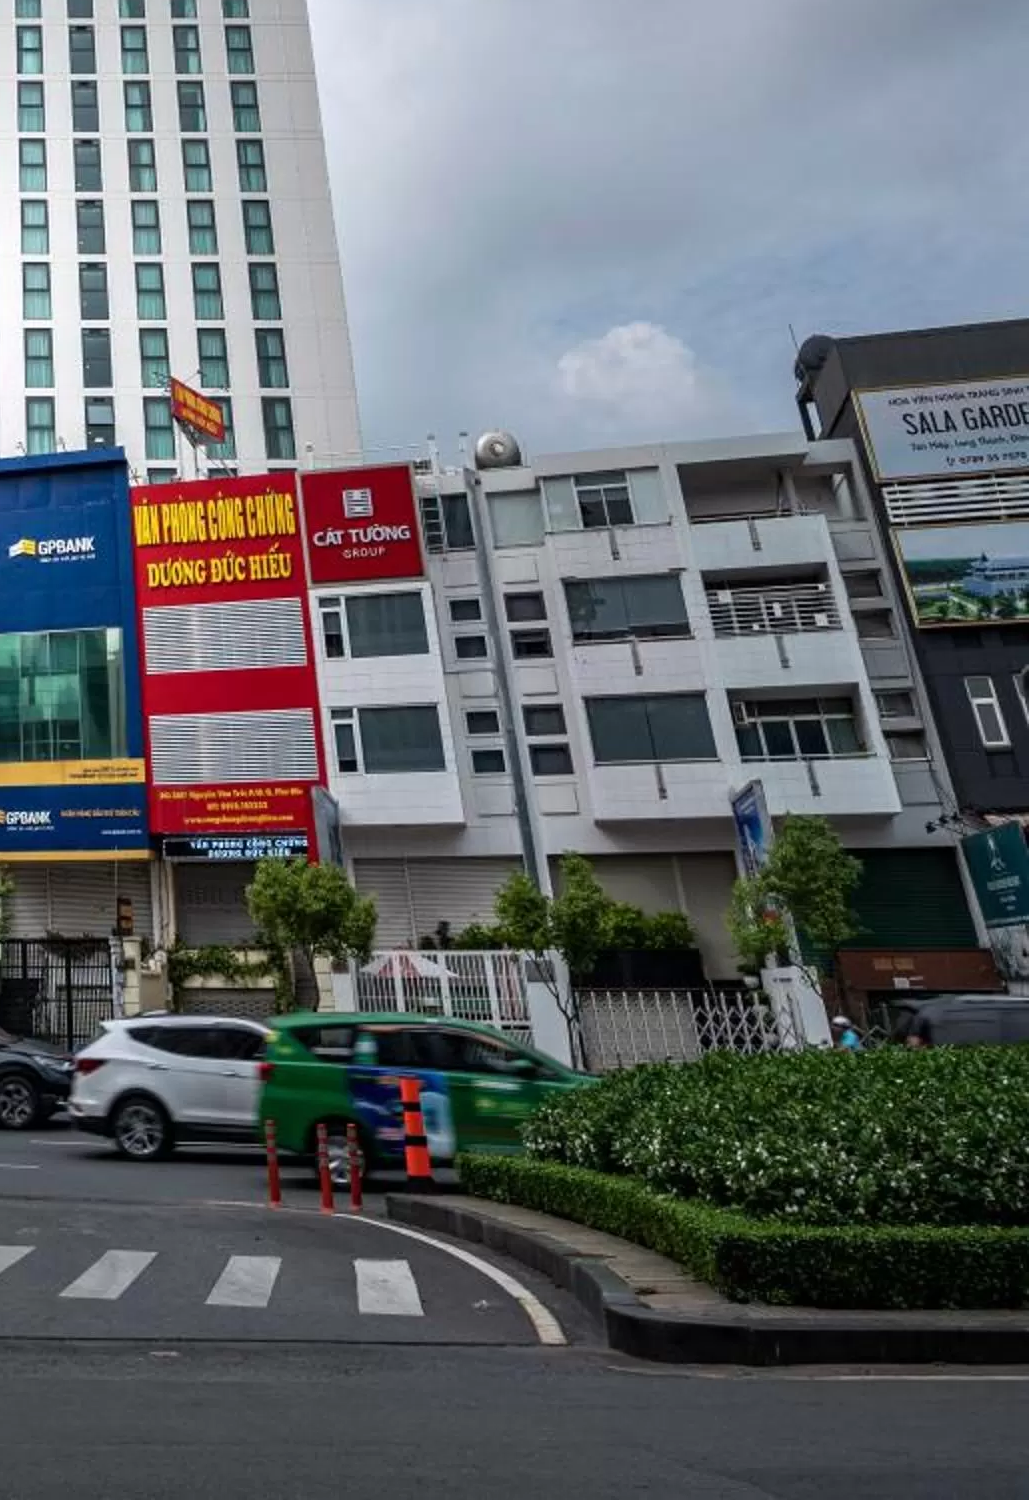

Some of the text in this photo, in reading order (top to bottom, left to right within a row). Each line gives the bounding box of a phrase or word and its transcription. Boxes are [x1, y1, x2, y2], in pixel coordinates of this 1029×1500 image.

[902, 409, 957, 435] SALA
[133, 488, 296, 546] VĂN PHÒNG CÔNG CHỨNG
[38, 536, 95, 555] GPBANK
[312, 527, 345, 546] CÁT
[343, 546, 386, 559] GROUP
[146, 542, 292, 587] DƯƠNG ĐỨC HIẾU
[6, 811, 52, 825] GPBANK
